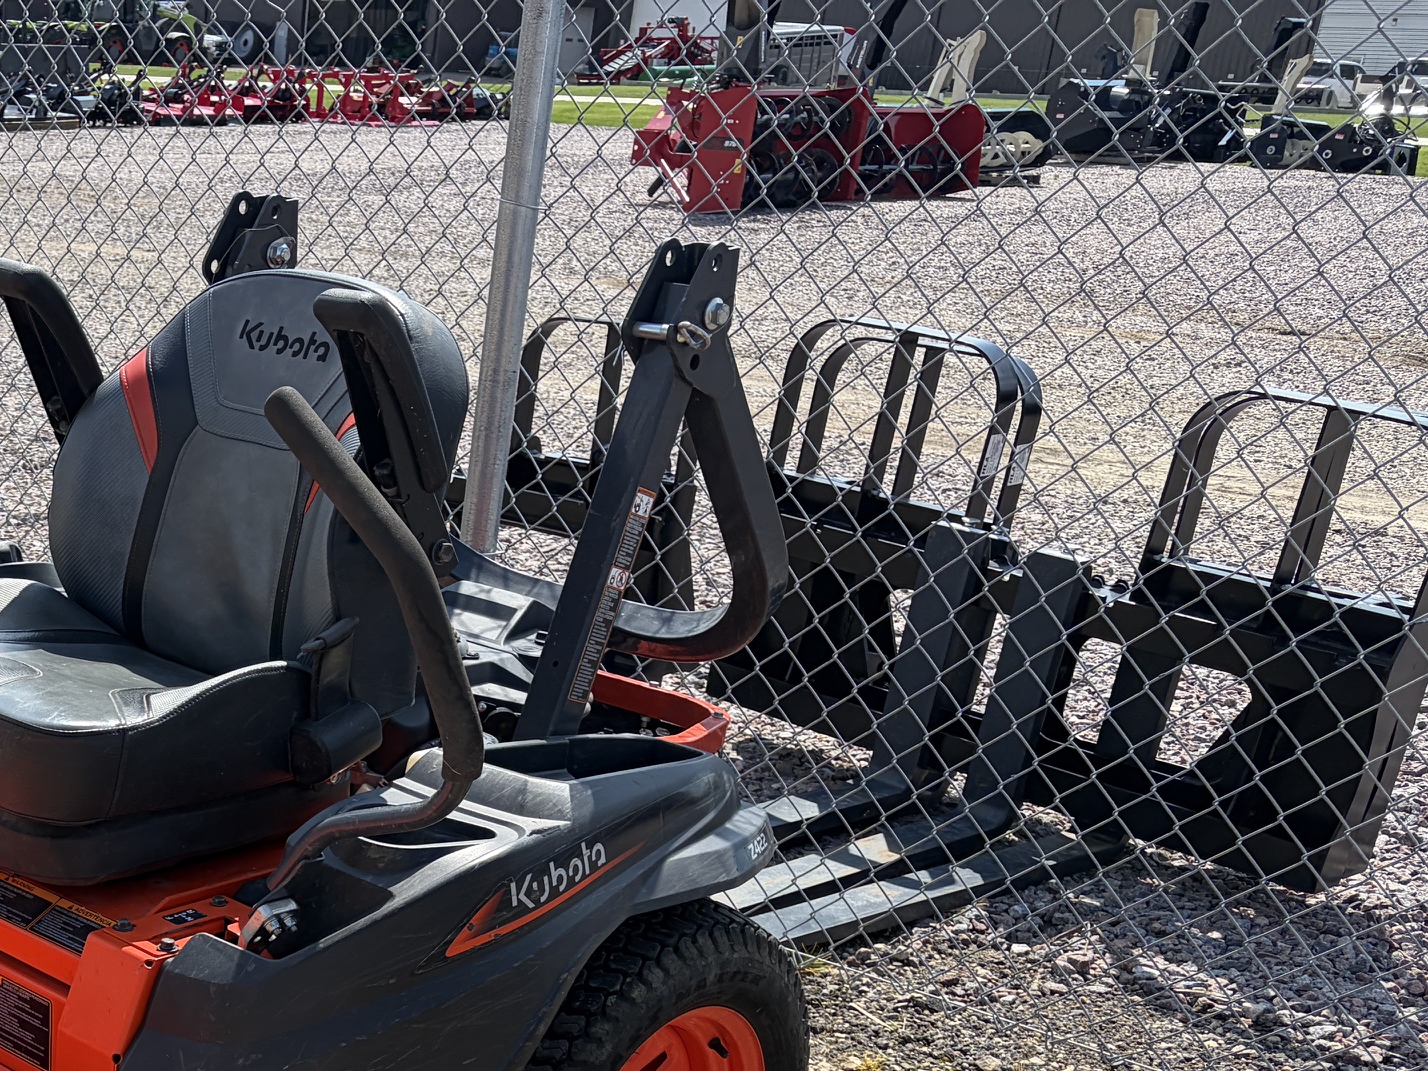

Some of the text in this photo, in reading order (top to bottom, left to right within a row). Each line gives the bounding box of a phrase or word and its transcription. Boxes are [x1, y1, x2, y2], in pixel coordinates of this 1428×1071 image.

[239, 319, 331, 362] Kubota
[746, 833, 769, 861] Z422
[509, 841, 607, 909] Kubota
